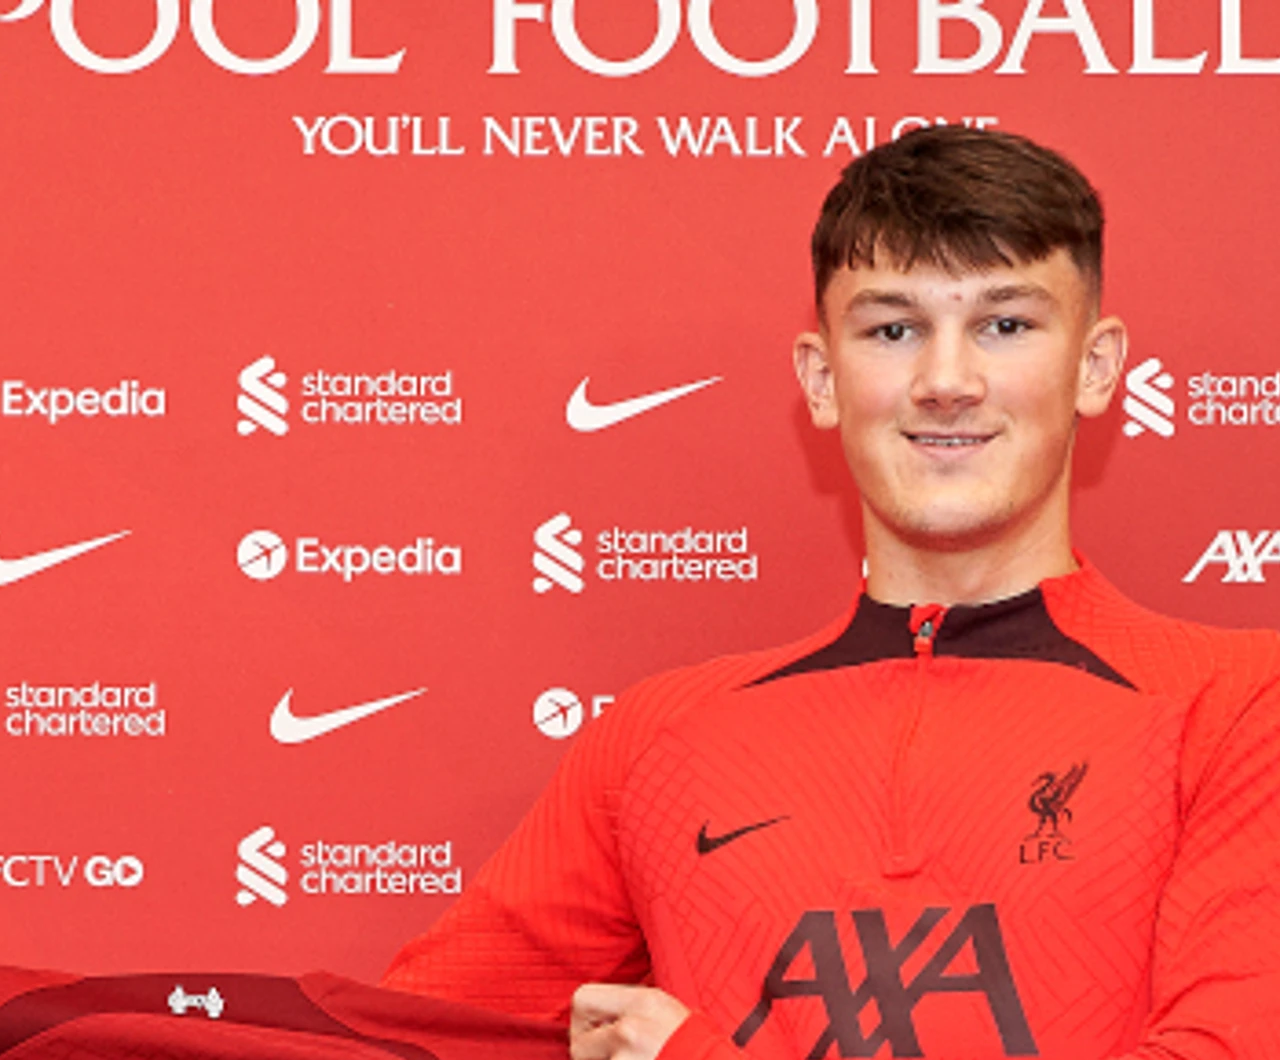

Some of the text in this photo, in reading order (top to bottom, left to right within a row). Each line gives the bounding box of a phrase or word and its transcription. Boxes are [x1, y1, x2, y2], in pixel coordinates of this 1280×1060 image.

[292, 114, 465, 157] YOU'LL
[483, 116, 644, 157] NEVER
[656, 116, 807, 158] WALK
[301, 369, 452, 396] standard
[1, 380, 165, 425] Expedia
[300, 396, 461, 425] chartered
[597, 527, 747, 554] standard
[296, 537, 461, 582] Expedia
[596, 554, 758, 581] chartered
[5, 681, 156, 709] standard
[5, 709, 165, 736] chartered
[300, 840, 451, 867] standard
[84, 856, 144, 887] GO
[300, 867, 461, 893] chartered
[730, 903, 1039, 1060] AXA
